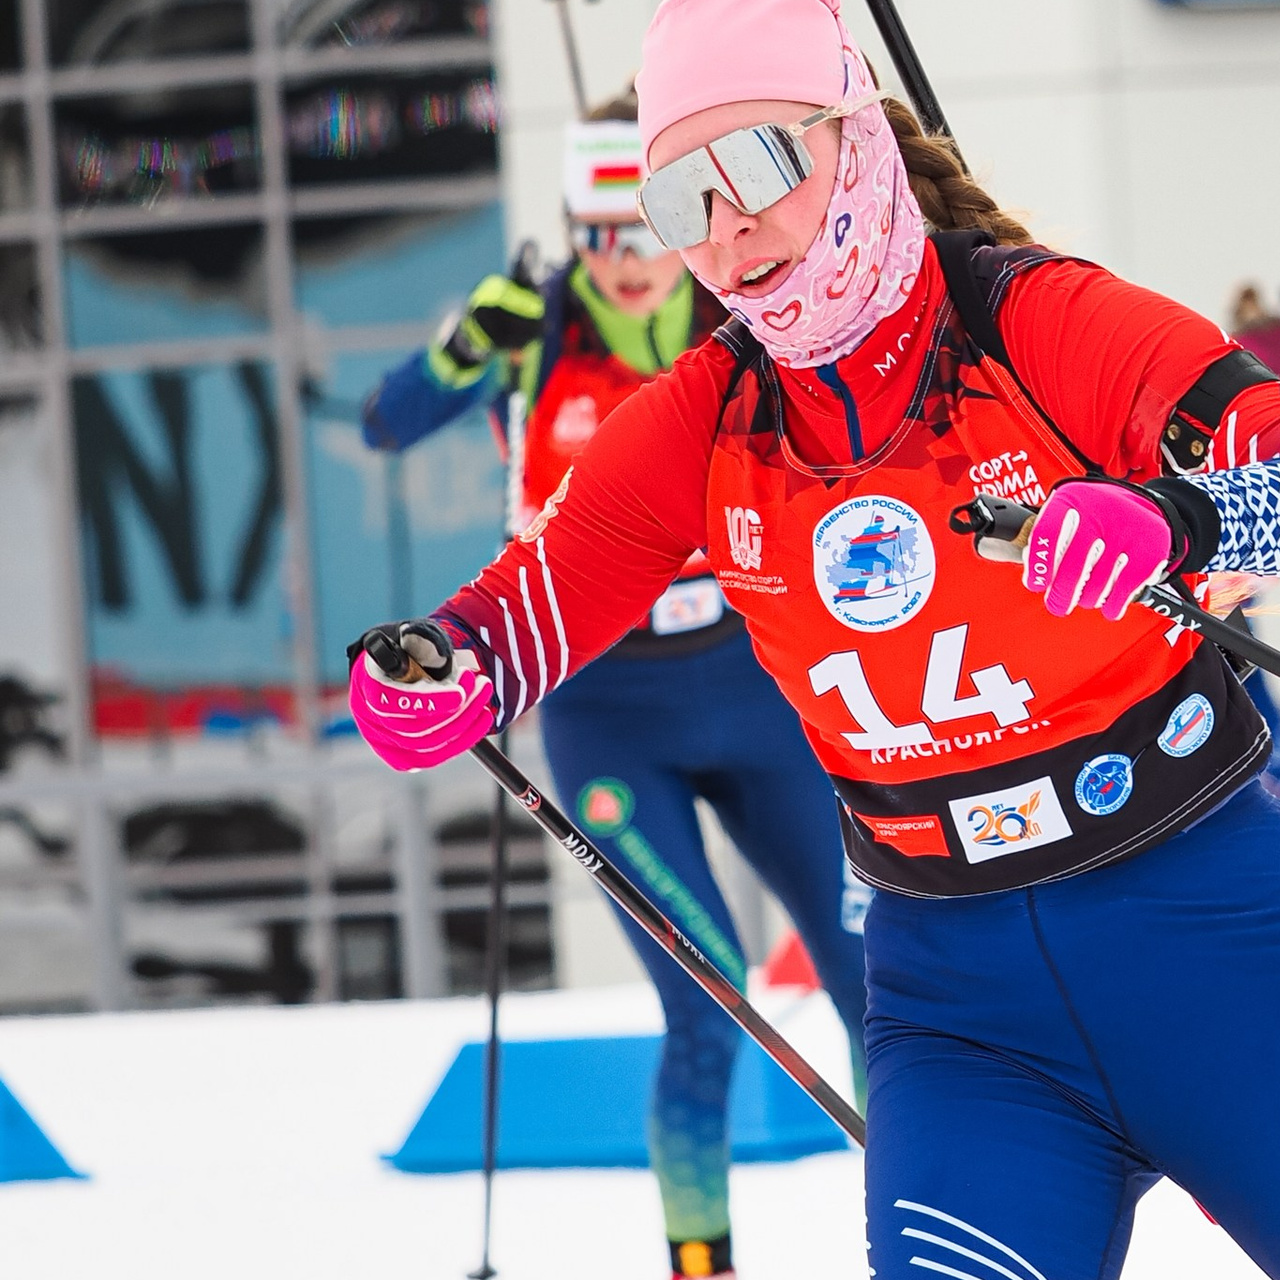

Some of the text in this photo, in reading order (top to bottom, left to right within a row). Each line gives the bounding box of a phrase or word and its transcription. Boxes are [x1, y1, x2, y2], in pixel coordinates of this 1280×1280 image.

[815, 499, 918, 547] ПЕРВЕНСТВО РОССИИ
[843, 611, 900, 628] Красноярск
[807, 622, 1036, 750] 14
[561, 833, 604, 875] MOAX
